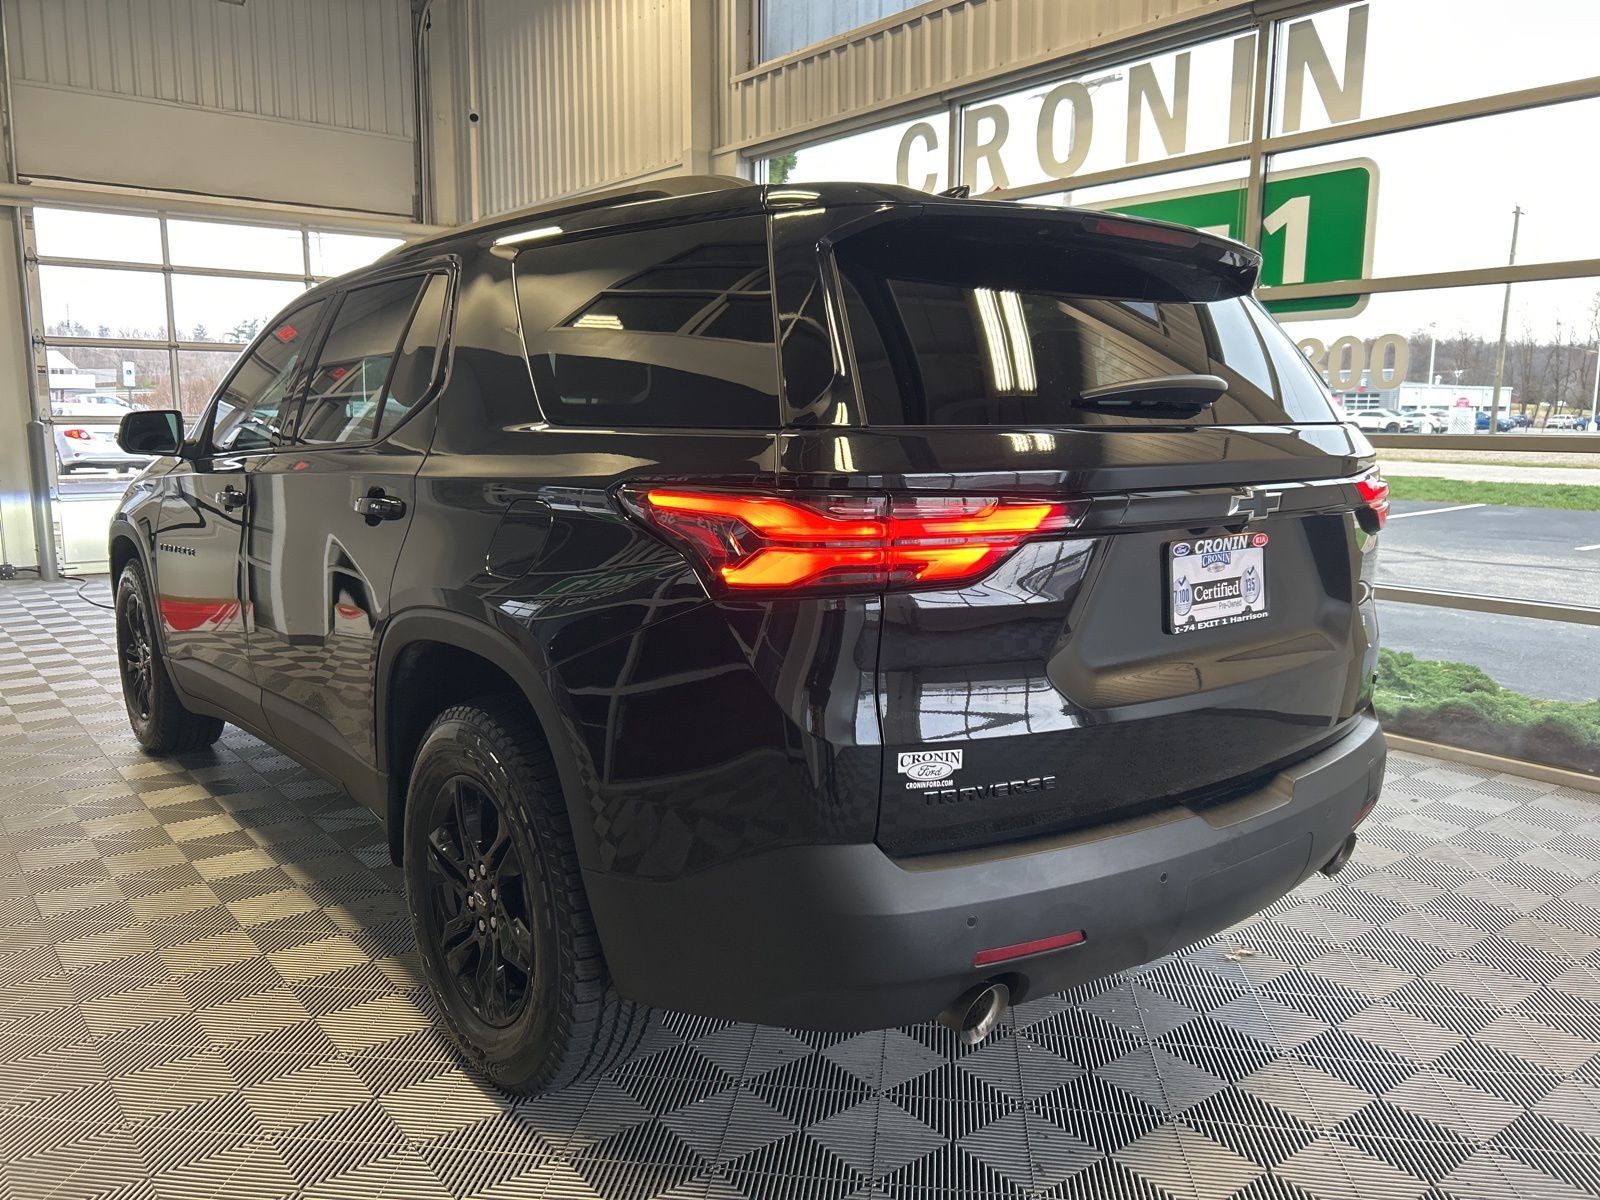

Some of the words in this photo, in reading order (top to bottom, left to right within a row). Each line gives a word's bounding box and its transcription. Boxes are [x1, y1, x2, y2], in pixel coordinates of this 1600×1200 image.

[896, 3, 1369, 195] CRONIN
[1263, 195, 1311, 285] 1
[1194, 535, 1248, 554] CRONIN
[1202, 552, 1230, 566] CRONIN
[1194, 580, 1240, 601] Certified
[1174, 625, 1195, 634] I-74
[1198, 619, 1220, 629] EXIT
[1230, 611, 1268, 624] Harrison
[900, 751, 960, 767] CRONIN
[917, 764, 943, 777] Ford
[906, 780, 954, 789] CRONINFORD.COM
[923, 776, 1056, 806] TRAVERSE
